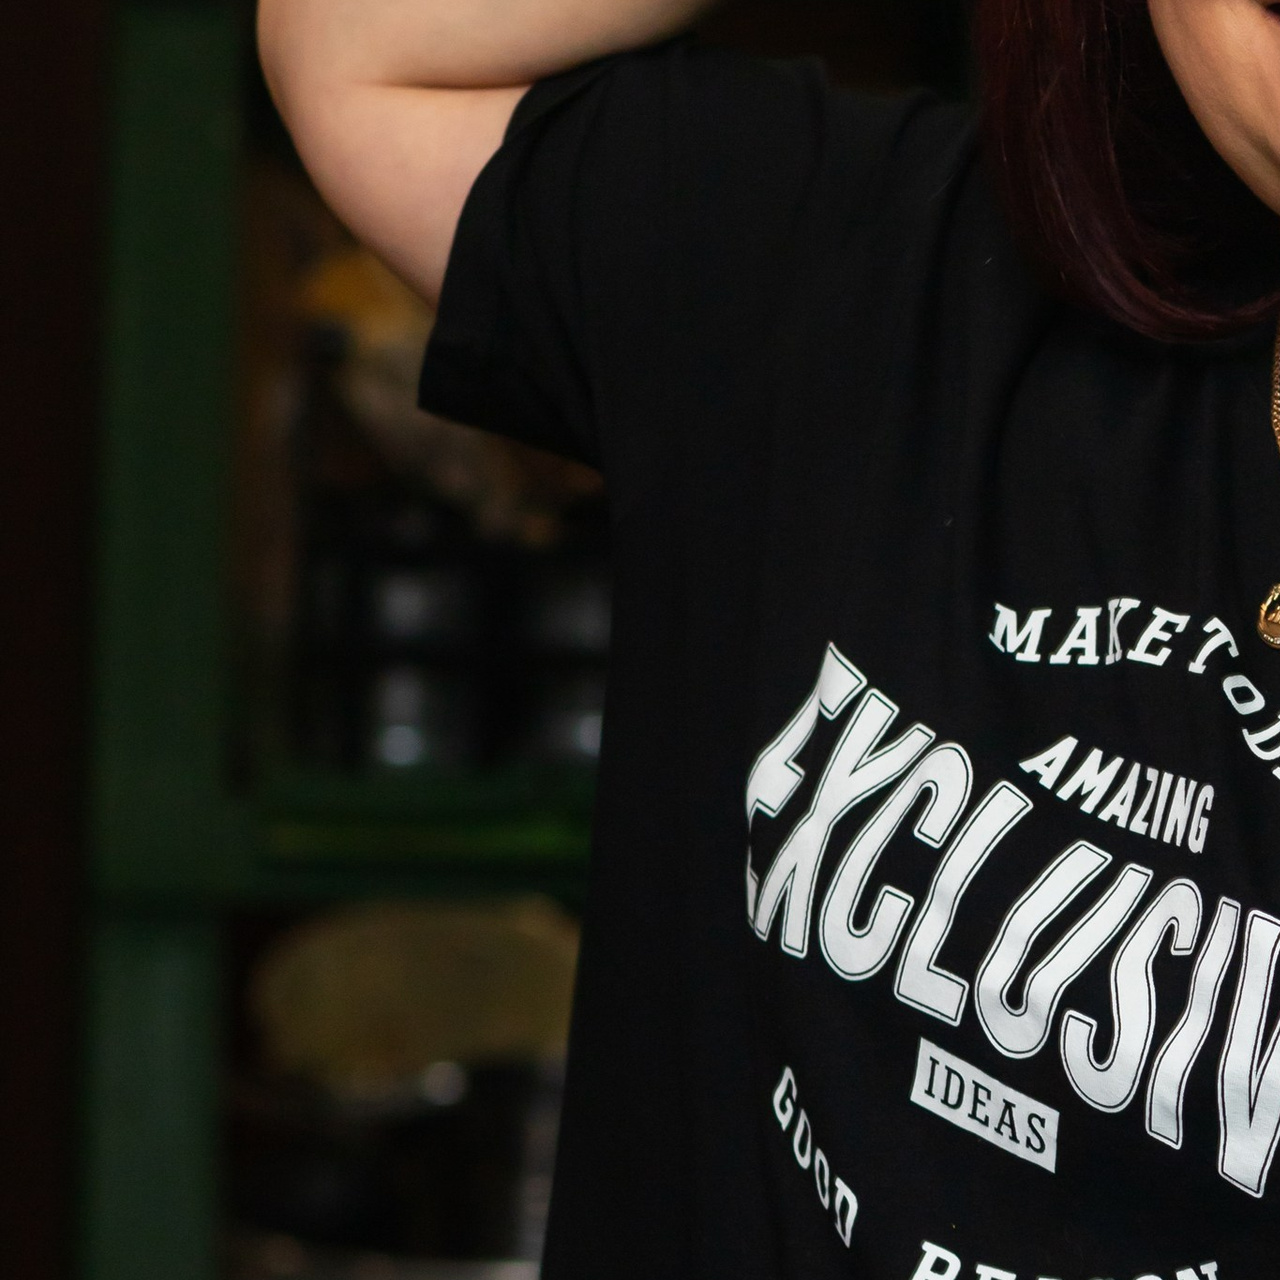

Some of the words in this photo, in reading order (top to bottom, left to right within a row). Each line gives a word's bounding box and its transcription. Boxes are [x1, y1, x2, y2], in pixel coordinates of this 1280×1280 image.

[988, 597, 1191, 667] MAKE
[1018, 735, 1215, 854] AMAZING
[772, 1066, 859, 1248] GOOD
[923, 1056, 1047, 1154] IDEAS
